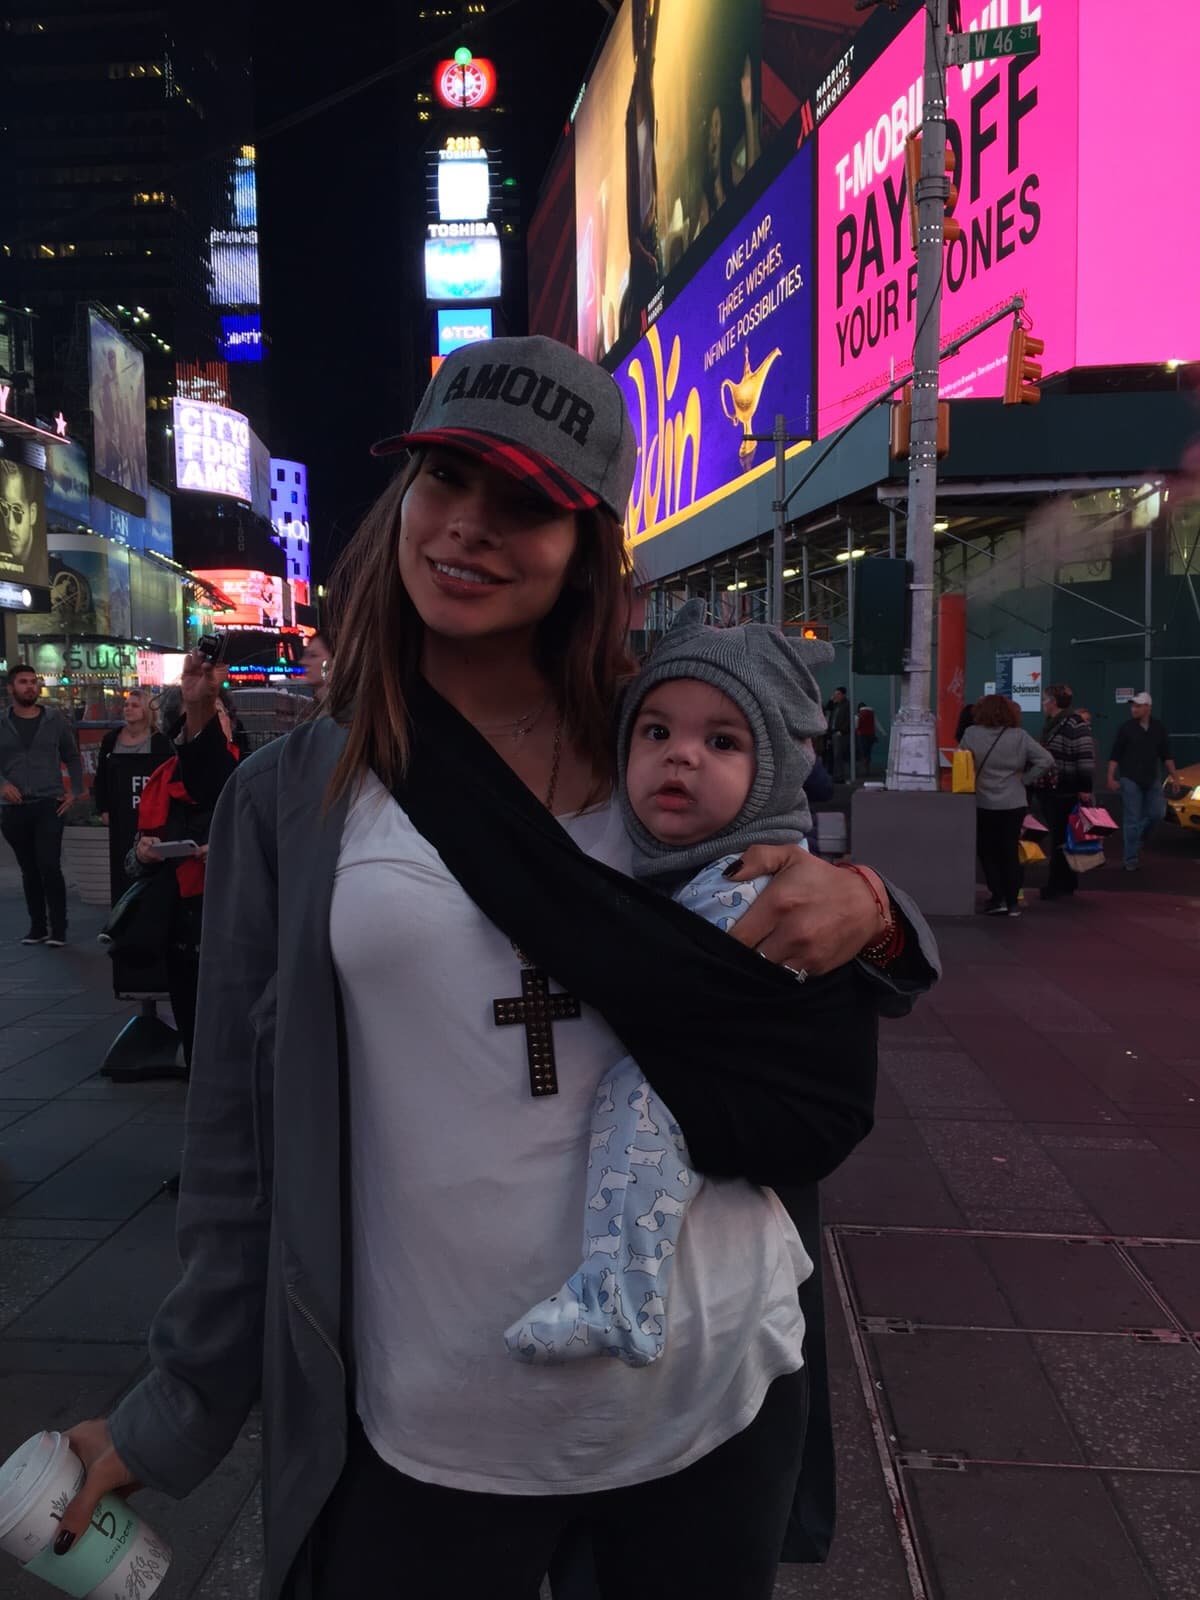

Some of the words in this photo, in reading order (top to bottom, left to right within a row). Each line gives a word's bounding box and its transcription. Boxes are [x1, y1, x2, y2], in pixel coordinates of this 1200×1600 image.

[816, 45, 854, 102] MARRIOTT
[975, 34, 988, 57] W
[993, 30, 1013, 54] 46
[1020, 26, 1033, 40] ST
[816, 71, 850, 120] MARQUIS
[835, 74, 949, 212] T-MOBIL
[427, 222, 498, 238] TOSHIBA
[726, 244, 744, 281] ONE
[745, 214, 773, 261] LAMP.
[837, 163, 907, 309] PAY
[718, 280, 744, 325] THREE
[745, 242, 783, 297] WISHES.
[836, 280, 900, 367] YOUR
[907, 173, 1041, 322] PONES
[453, 325, 488, 340] TDK
[704, 325, 736, 372] INFINITE
[736, 263, 804, 342] POSSIBILITIES.
[441, 364, 595, 446] AMOUR
